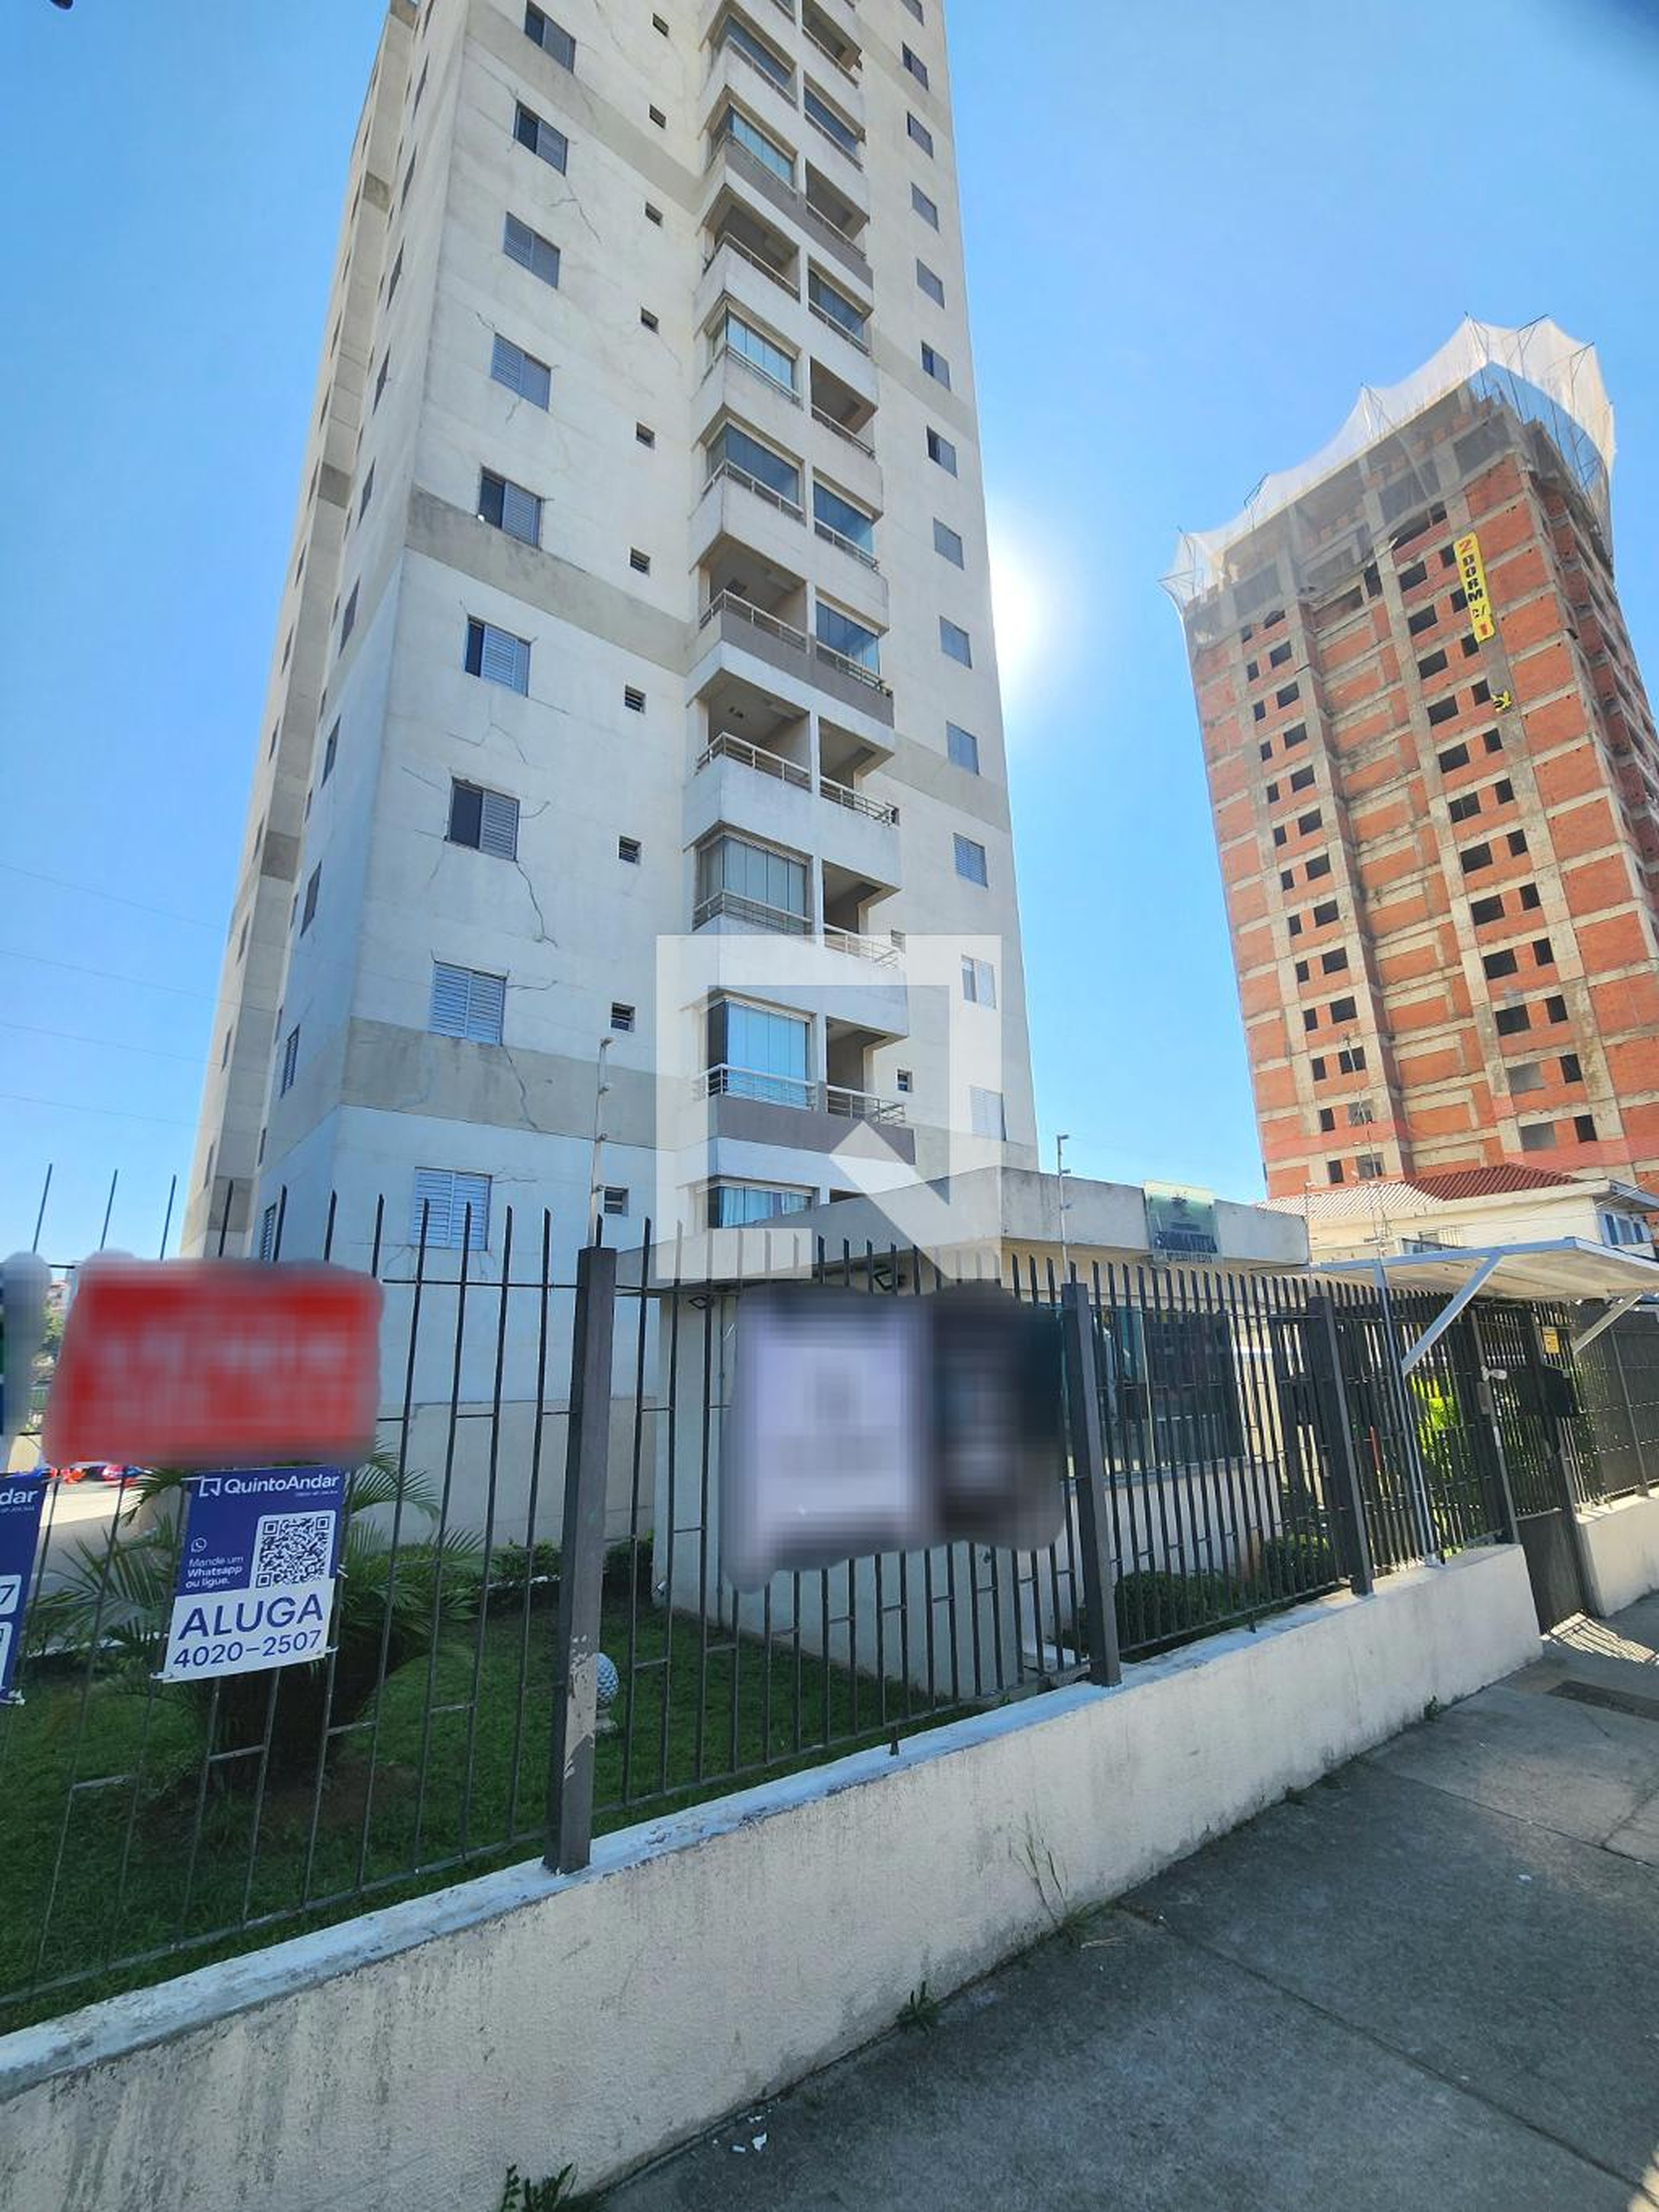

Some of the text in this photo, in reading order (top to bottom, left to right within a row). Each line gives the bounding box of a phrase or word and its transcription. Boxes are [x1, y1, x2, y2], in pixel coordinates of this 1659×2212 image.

[1459, 539, 1472, 554] 2
[1462, 554, 1483, 602] DORM
[224, 1474, 340, 1495] QuintoAndar
[189, 1556, 244, 1568] Mande um
[187, 1566, 242, 1578] Whatsapp
[185, 1580, 200, 1589] ou
[178, 1594, 324, 1640] ALUGA
[173, 1630, 322, 1668] 4020-2507
